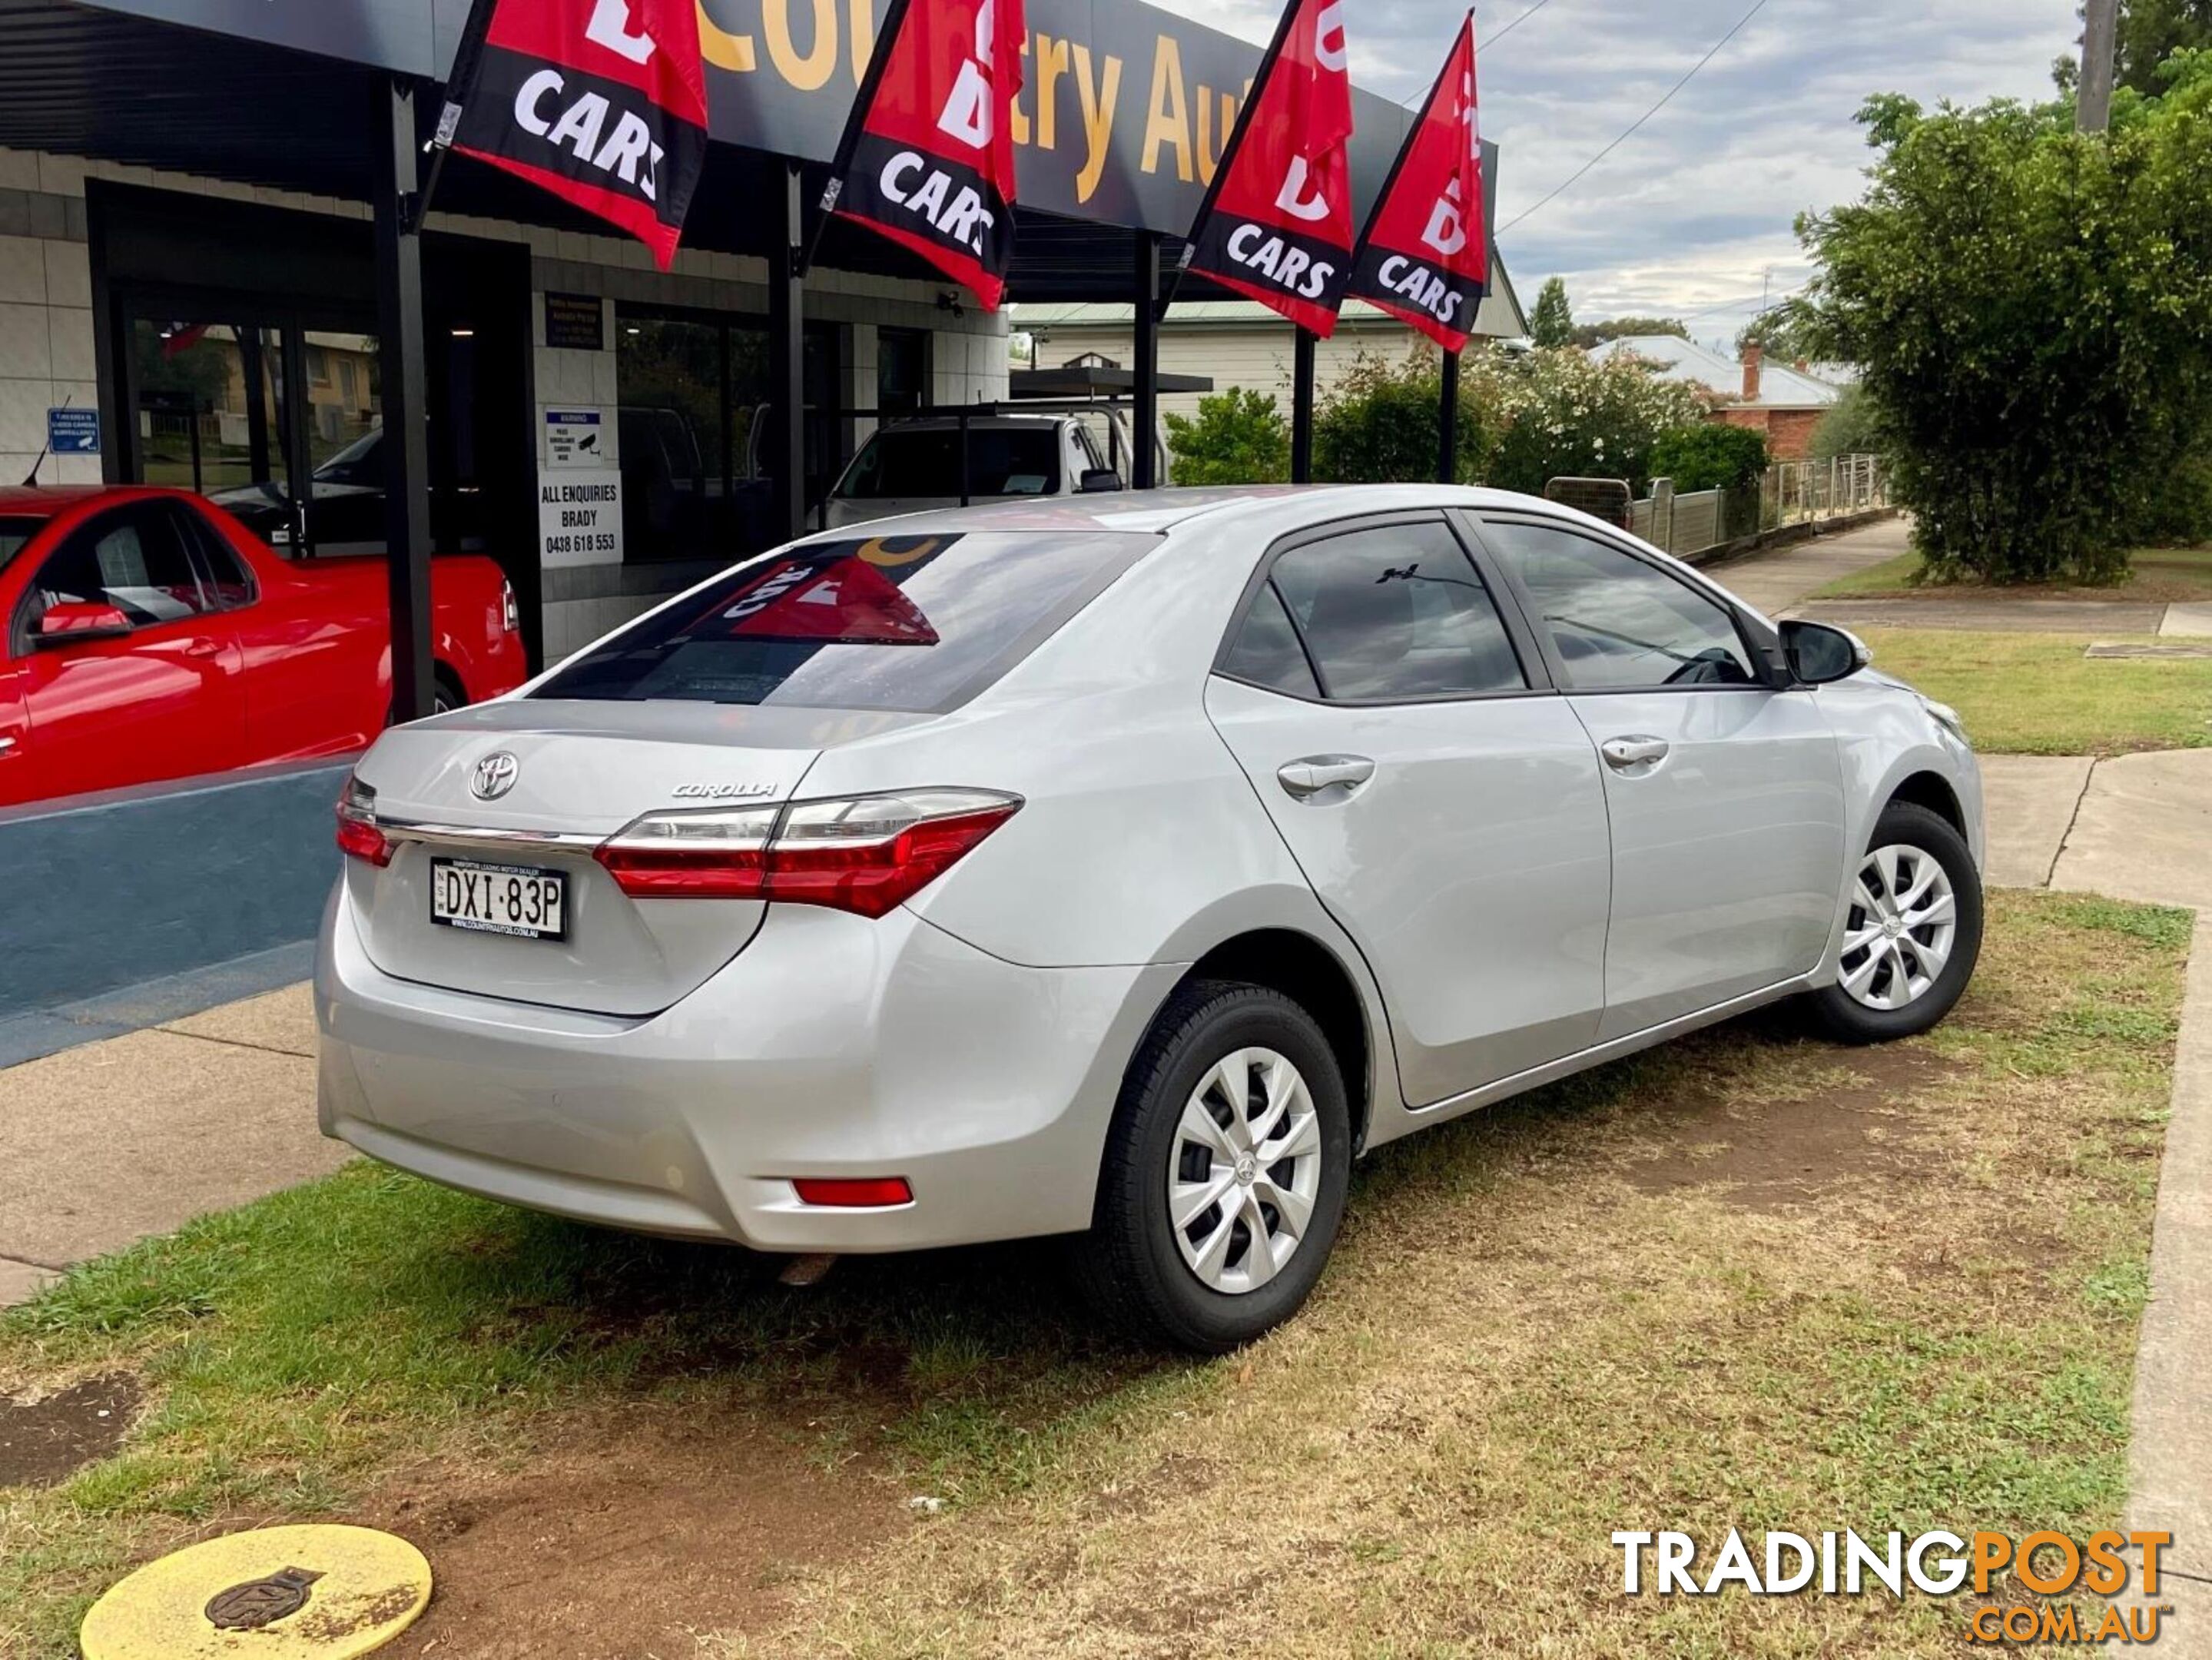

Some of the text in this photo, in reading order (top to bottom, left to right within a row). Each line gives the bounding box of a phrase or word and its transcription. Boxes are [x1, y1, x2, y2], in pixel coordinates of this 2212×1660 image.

[514, 69, 665, 201] CARS
[880, 151, 994, 256] CARS
[1227, 224, 1335, 298] CARS
[1378, 255, 1462, 322] CARS
[542, 485, 616, 504] ALL ENQUIRIES
[562, 510, 597, 527] BRADY
[546, 533, 615, 553] 0438 618 553
[671, 782, 778, 798] COROLLA
